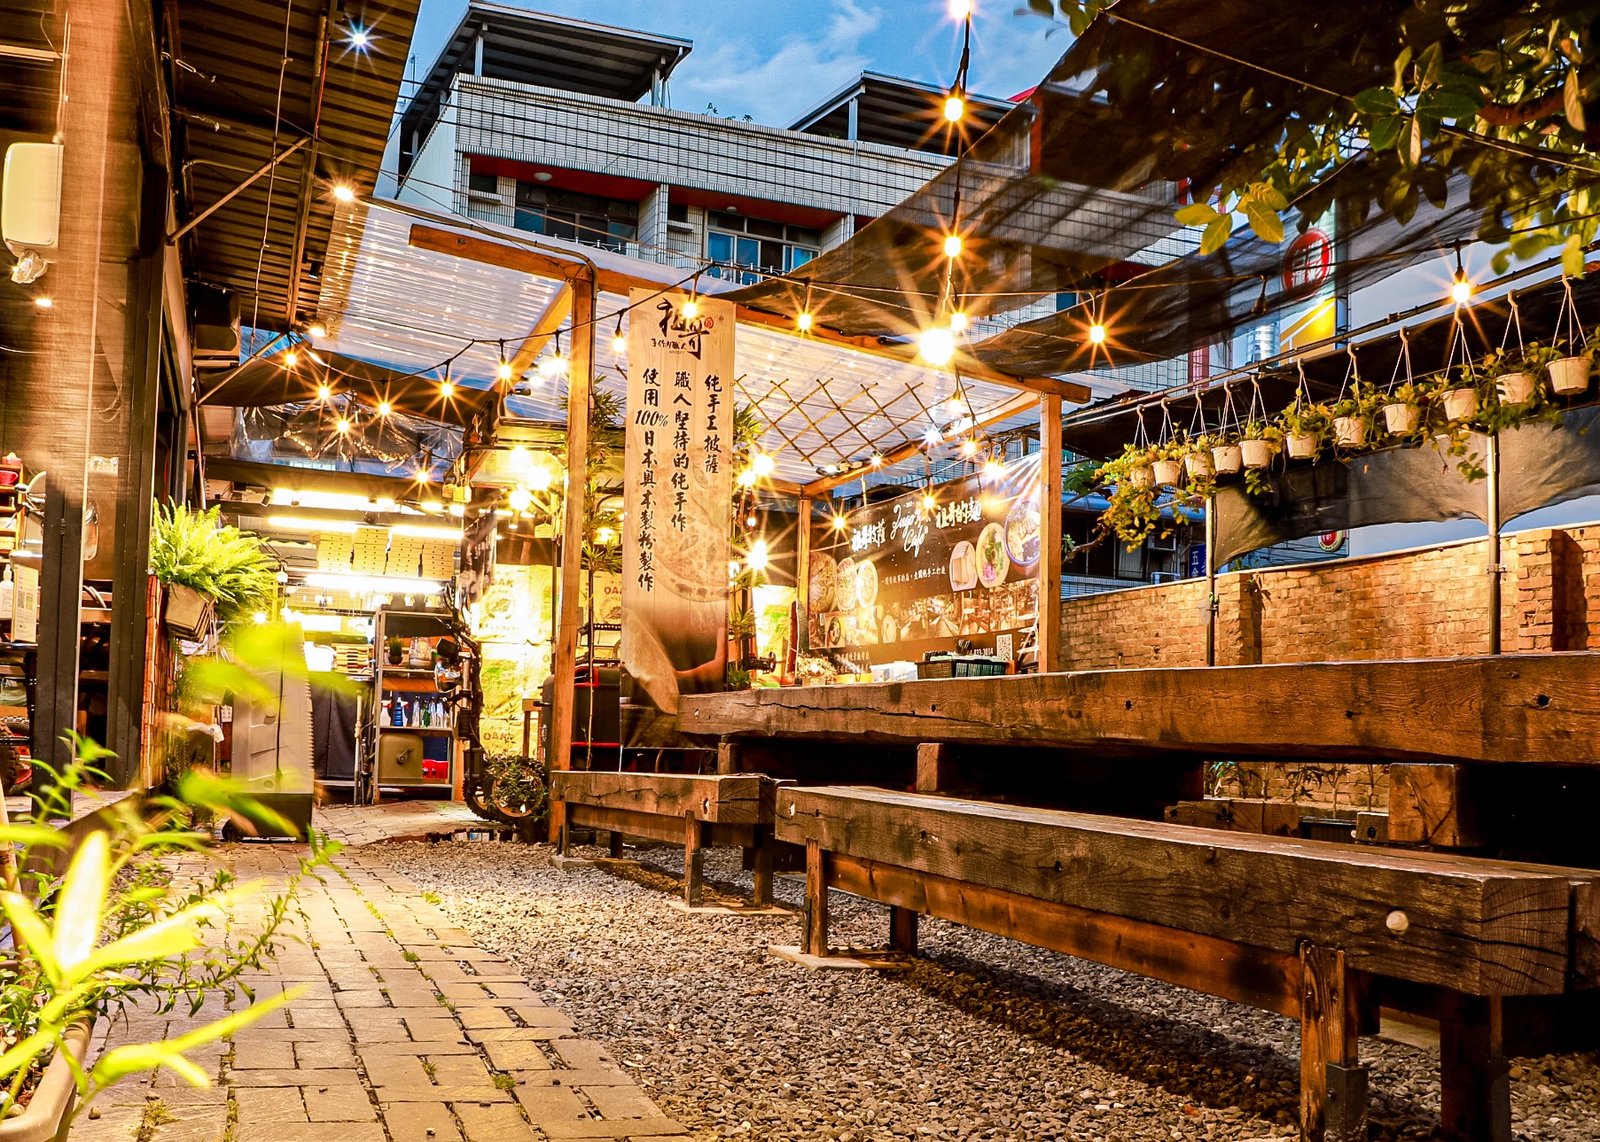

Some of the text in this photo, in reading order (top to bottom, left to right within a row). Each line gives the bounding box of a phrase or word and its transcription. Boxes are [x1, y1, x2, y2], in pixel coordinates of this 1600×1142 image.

[670, 370, 693, 533] 職人堅持的純手作
[703, 374, 723, 474] 純手工披薩
[604, 586, 622, 595] OA
